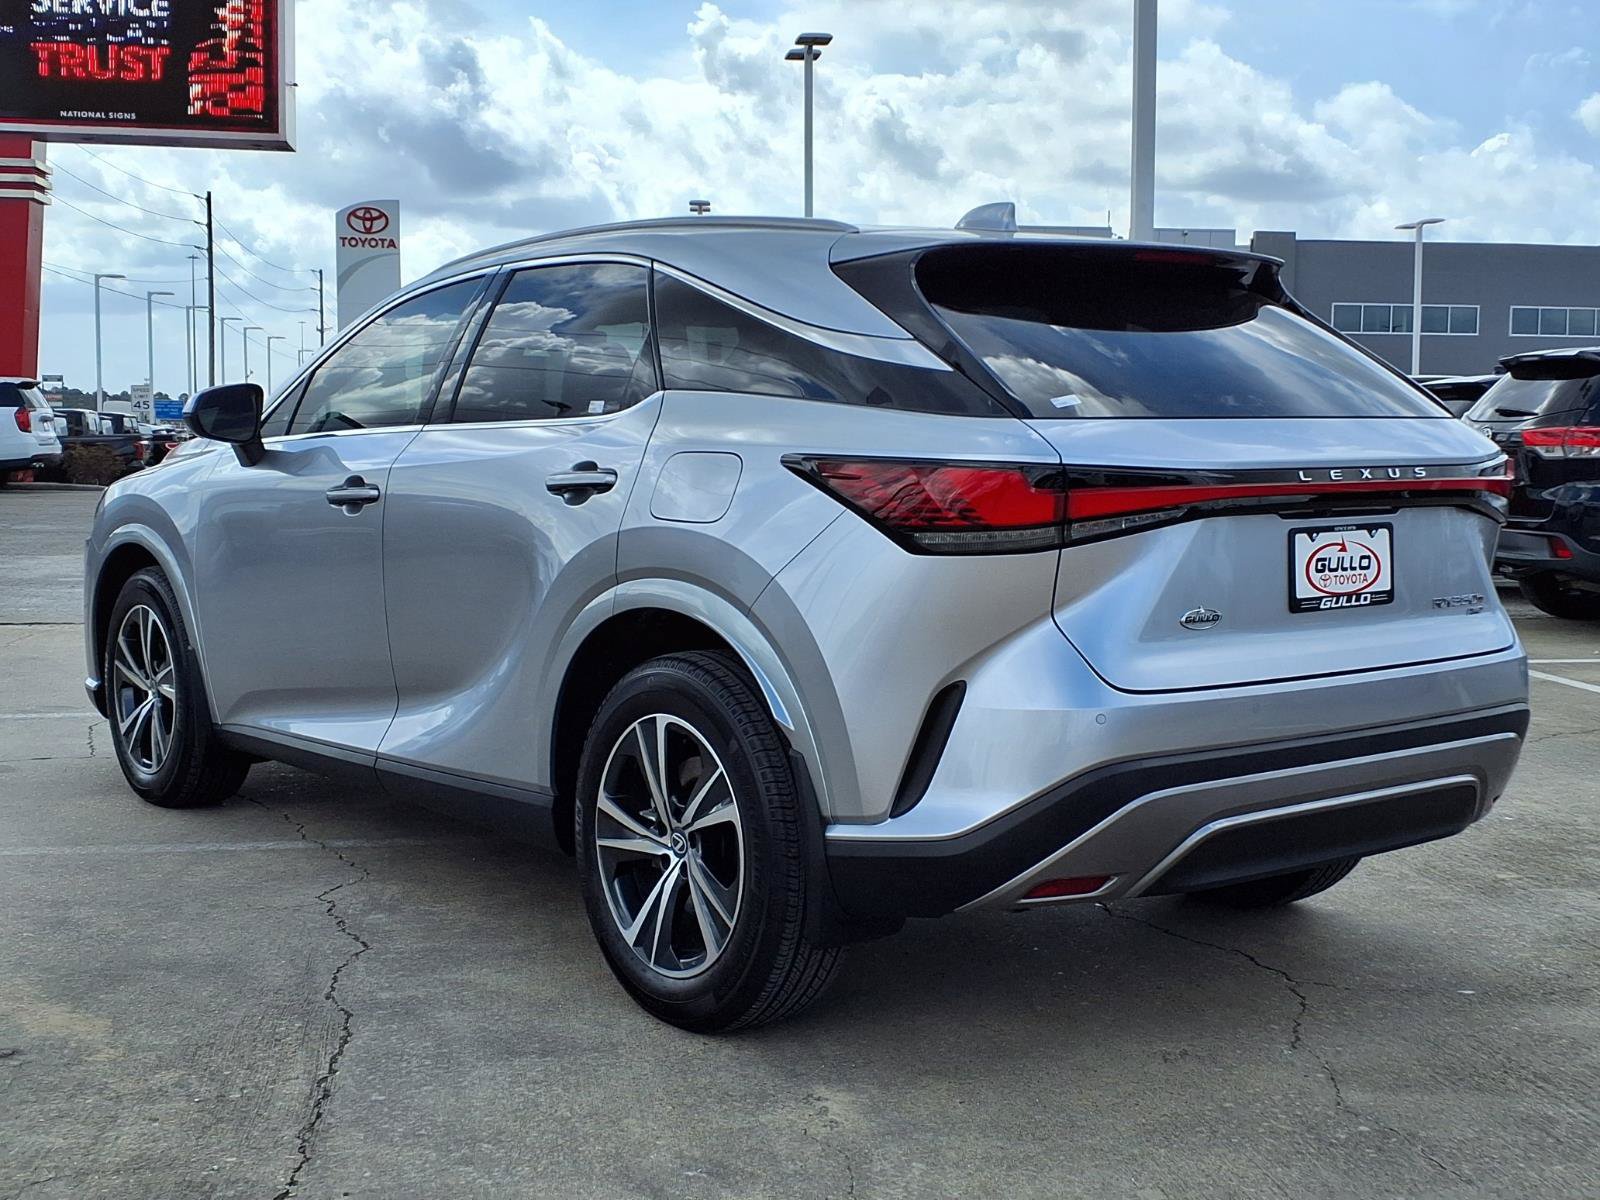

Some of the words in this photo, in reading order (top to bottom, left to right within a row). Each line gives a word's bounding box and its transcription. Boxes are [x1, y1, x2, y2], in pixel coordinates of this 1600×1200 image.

[30, 42, 171, 80] TRUST
[60, 110, 106, 119] NATIONAL
[108, 112, 137, 120] SIGNS
[339, 236, 397, 249] TOYOTA
[133, 400, 150, 410] 45
[1298, 466, 1427, 481] LEXUS
[1315, 554, 1372, 573] GULLO
[1333, 573, 1368, 586] TOYOTA
[1320, 594, 1371, 609] GULLO
[1184, 613, 1221, 623] GULLO
